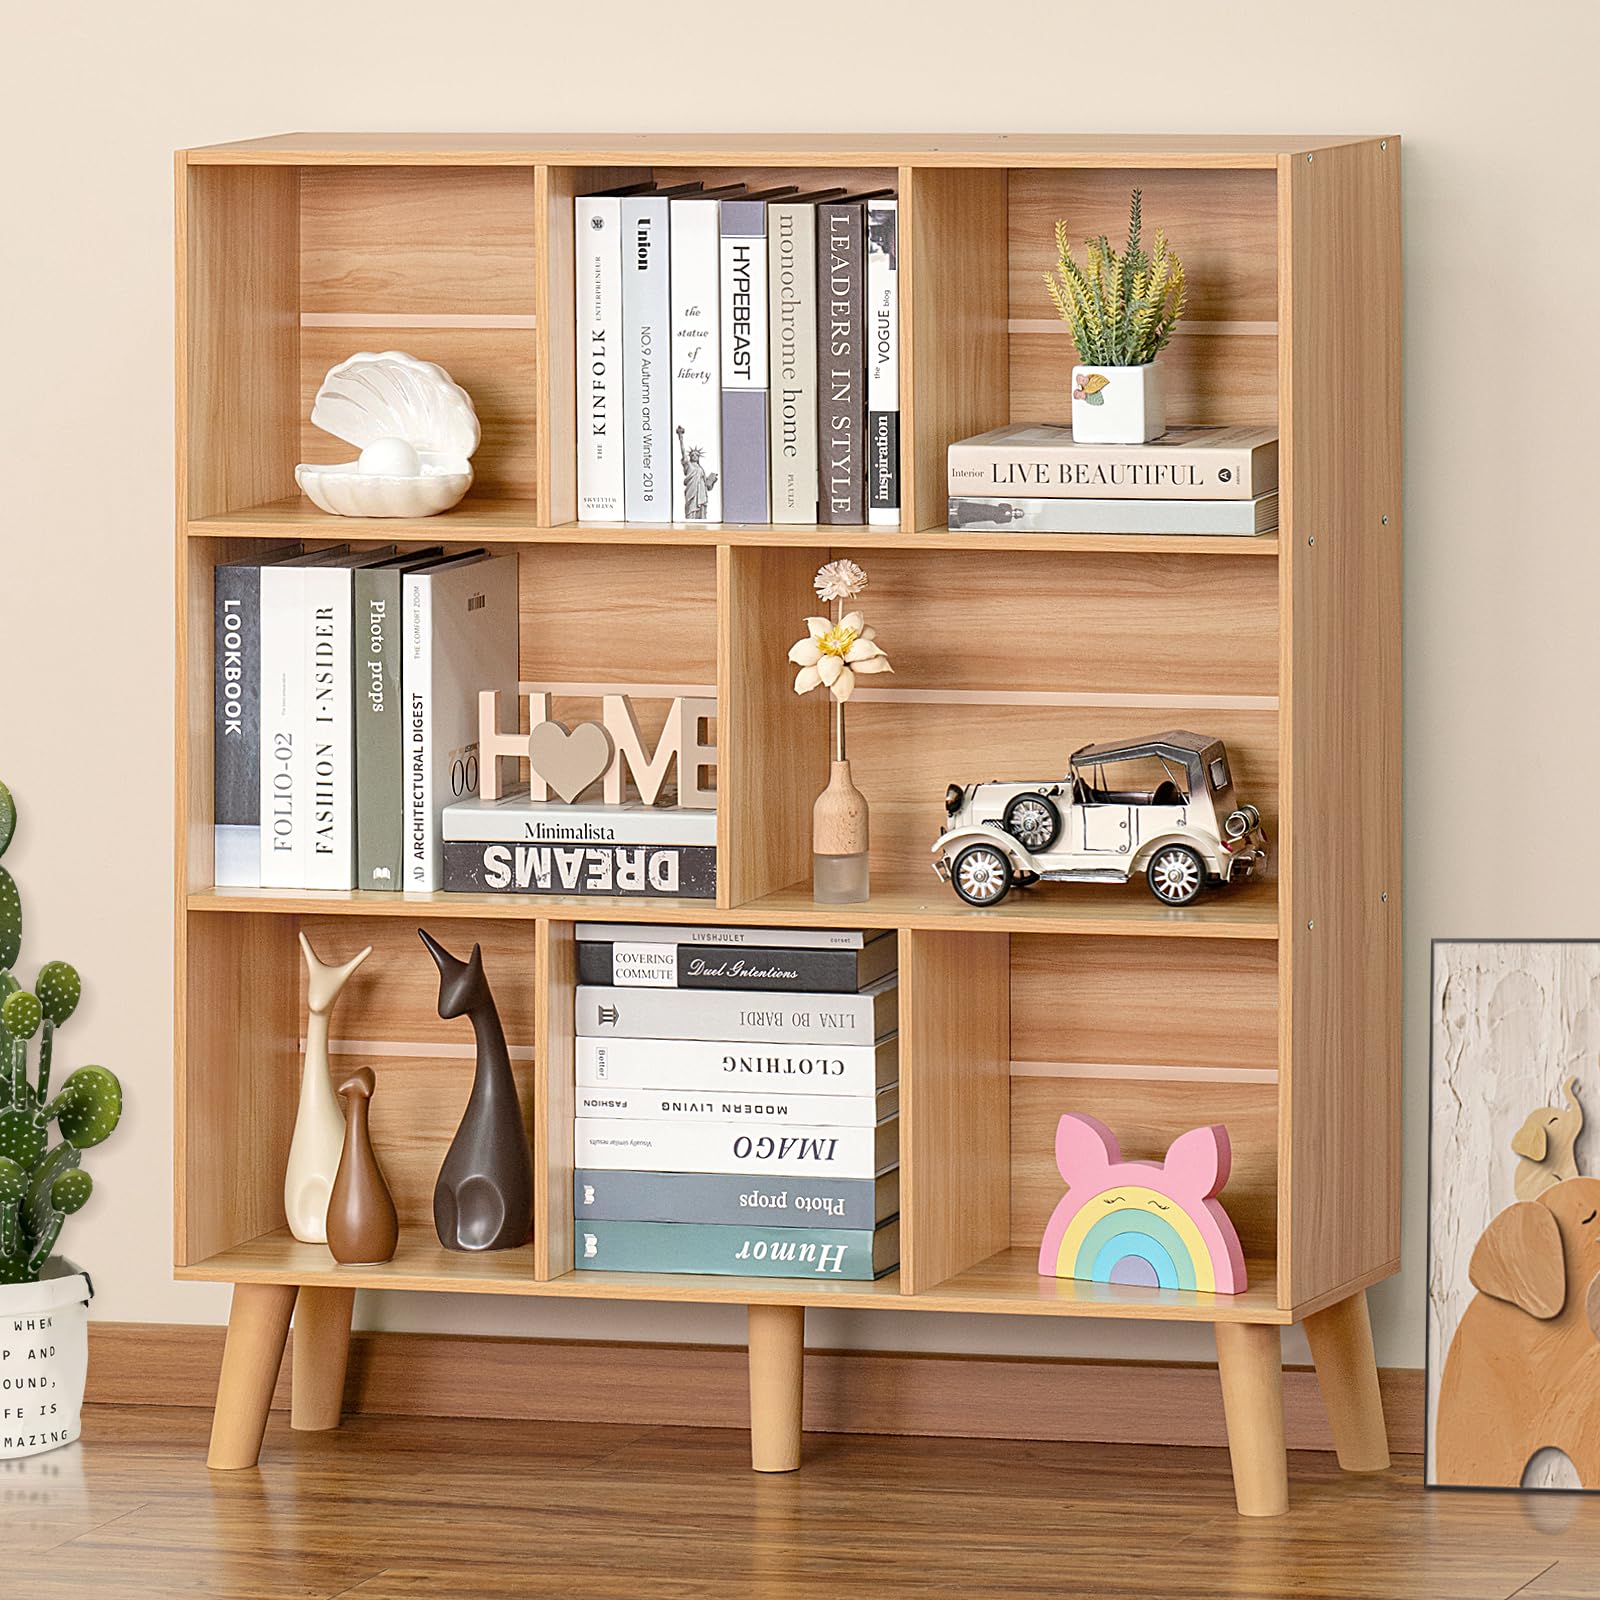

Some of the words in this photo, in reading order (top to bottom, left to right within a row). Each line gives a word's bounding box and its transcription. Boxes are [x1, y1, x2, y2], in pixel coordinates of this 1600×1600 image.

[638, 219, 650, 270] Union
[830, 215, 851, 355] LEADERS
[780, 216, 801, 379] monochrome
[883, 290, 891, 306] blog
[685, 306, 701, 316] the
[733, 247, 750, 380] HYPEBEAST
[641, 327, 651, 355] NO.9
[878, 310, 890, 363] VOGUE
[688, 347, 701, 362] of
[592, 330, 605, 435] KINFOLK
[641, 358, 651, 404] Autumn
[678, 368, 711, 384] liberty
[832, 369, 850, 403] IN
[643, 407, 652, 431] and
[783, 390, 802, 457] home
[643, 434, 652, 469] Winter
[875, 415, 889, 500] inspiration
[832, 415, 851, 513] STYLE
[952, 468, 984, 477] Interior
[994, 464, 1049, 483] LIVE
[1060, 464, 1203, 485] BEAUTIFUL
[643, 473, 653, 501] 2018
[369, 600, 385, 653] Photo
[224, 600, 242, 735] LOOKBOOK
[368, 661, 384, 712] props
[413, 693, 423, 742] DIGEST
[274, 733, 292, 850] FOLIO-02
[316, 745, 333, 853] FASHION
[413, 746, 424, 859] ARCHITECTURAL
[525, 822, 615, 840] Minimalista
[483, 845, 679, 891] DREAMS
[692, 933, 745, 942] LIVSHJULET
[615, 953, 674, 965] COVERING
[615, 968, 673, 980] COMMUTE
[741, 1012, 782, 1026] BARDI
[792, 1013, 809, 1027] BO
[820, 1014, 854, 1028] LINA
[723, 1057, 844, 1075] CLOTHING
[584, 1100, 627, 1108] FASHION
[662, 1102, 712, 1112] LIVING
[723, 1104, 787, 1114] MODERN
[734, 1137, 838, 1160] IMAGO
[740, 1191, 787, 1208] props
[794, 1196, 845, 1215] Photo
[735, 1240, 848, 1273] Humor
[3, 1350, 10, 1360] P
[28, 1346, 55, 1359] AND
[3, 1377, 55, 1389] OUND,
[5, 1408, 23, 1418] FE
[40, 1404, 56, 1415] IS
[4, 1430, 68, 1447] MAZING
